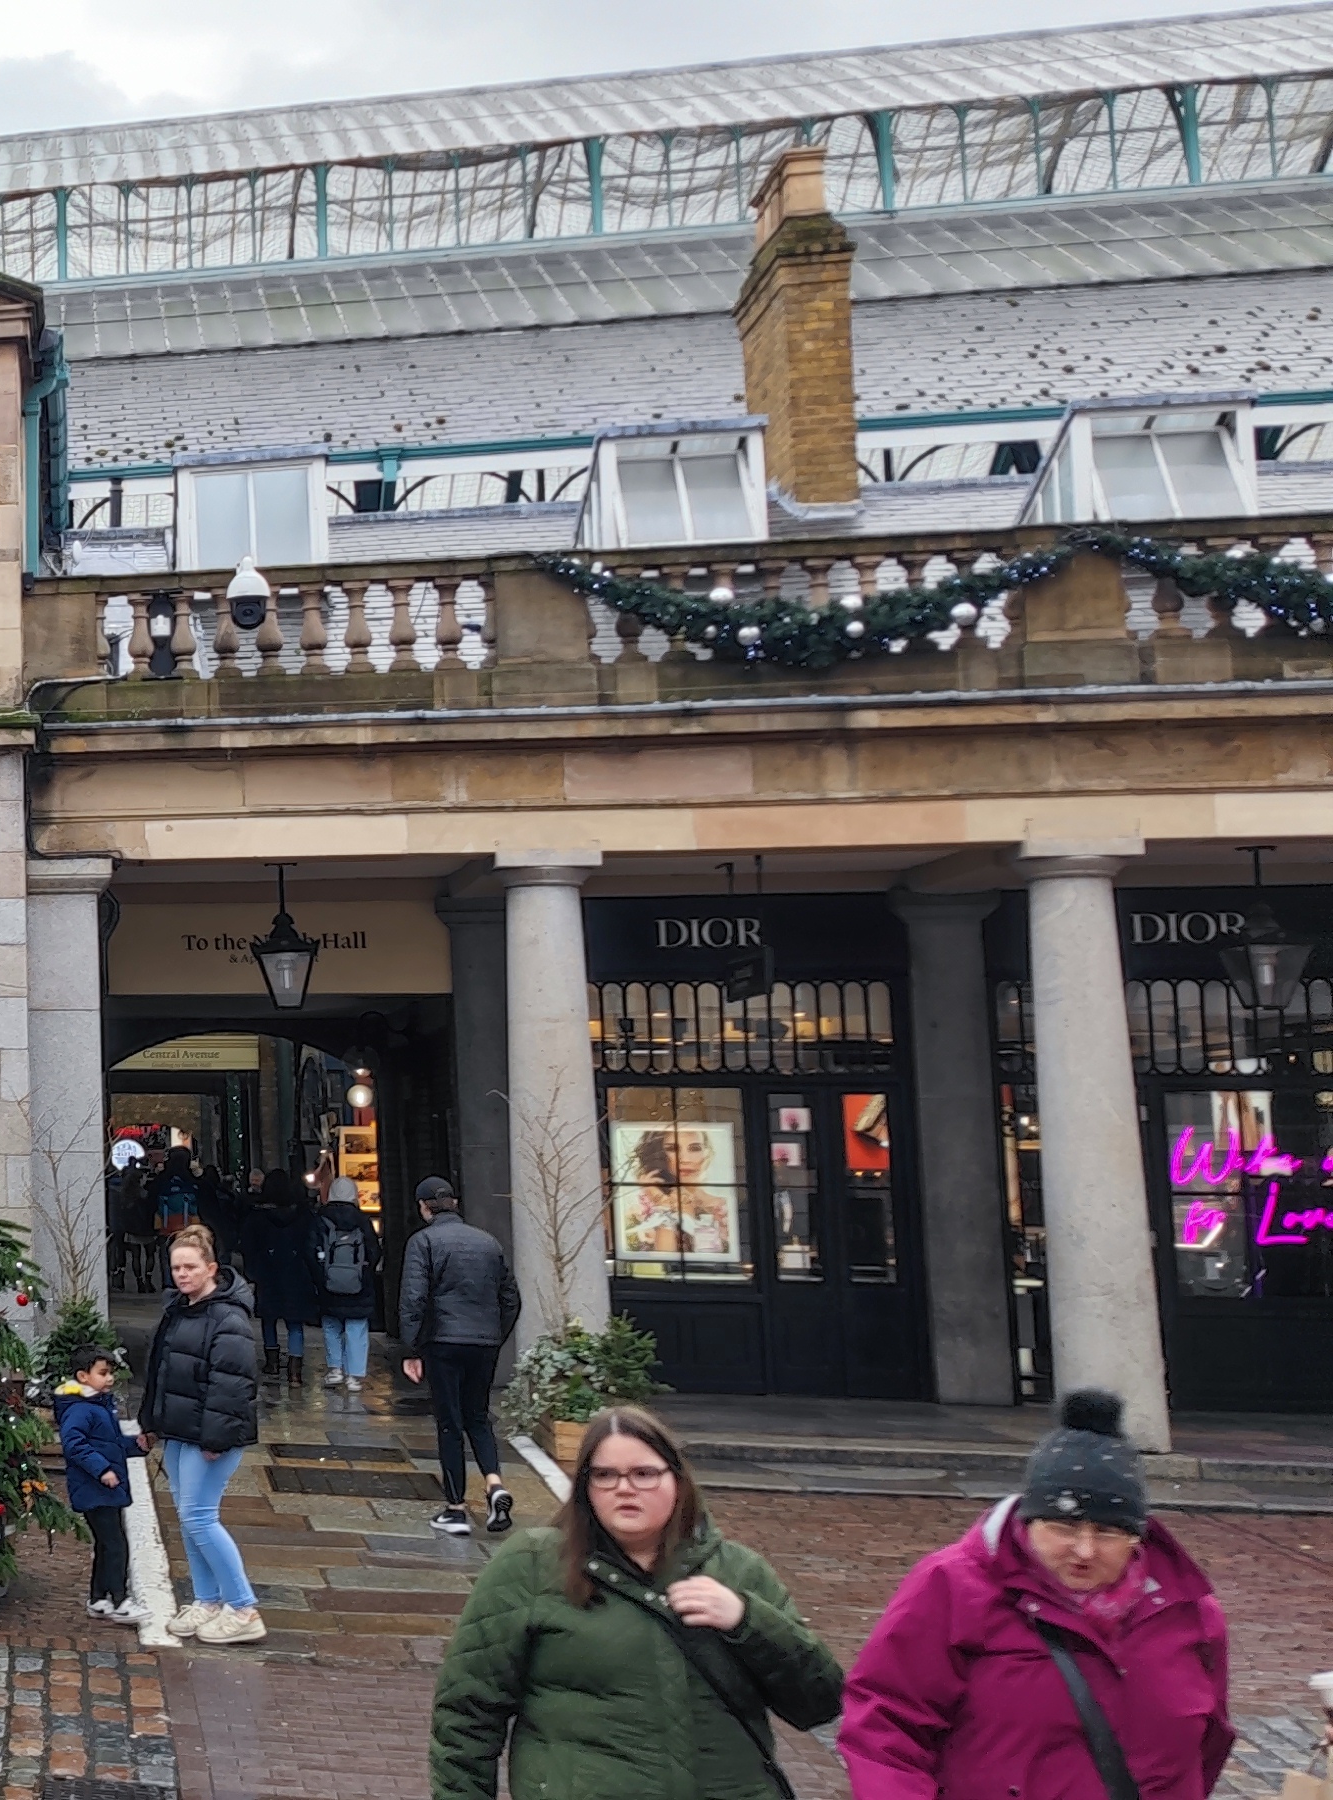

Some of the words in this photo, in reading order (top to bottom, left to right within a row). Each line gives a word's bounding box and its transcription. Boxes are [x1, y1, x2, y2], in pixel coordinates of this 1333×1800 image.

[181, 935, 209, 951] To
[214, 933, 247, 950] the
[320, 931, 367, 949] Hall
[654, 918, 762, 948] DIOR
[1129, 912, 1246, 944] DIOR
